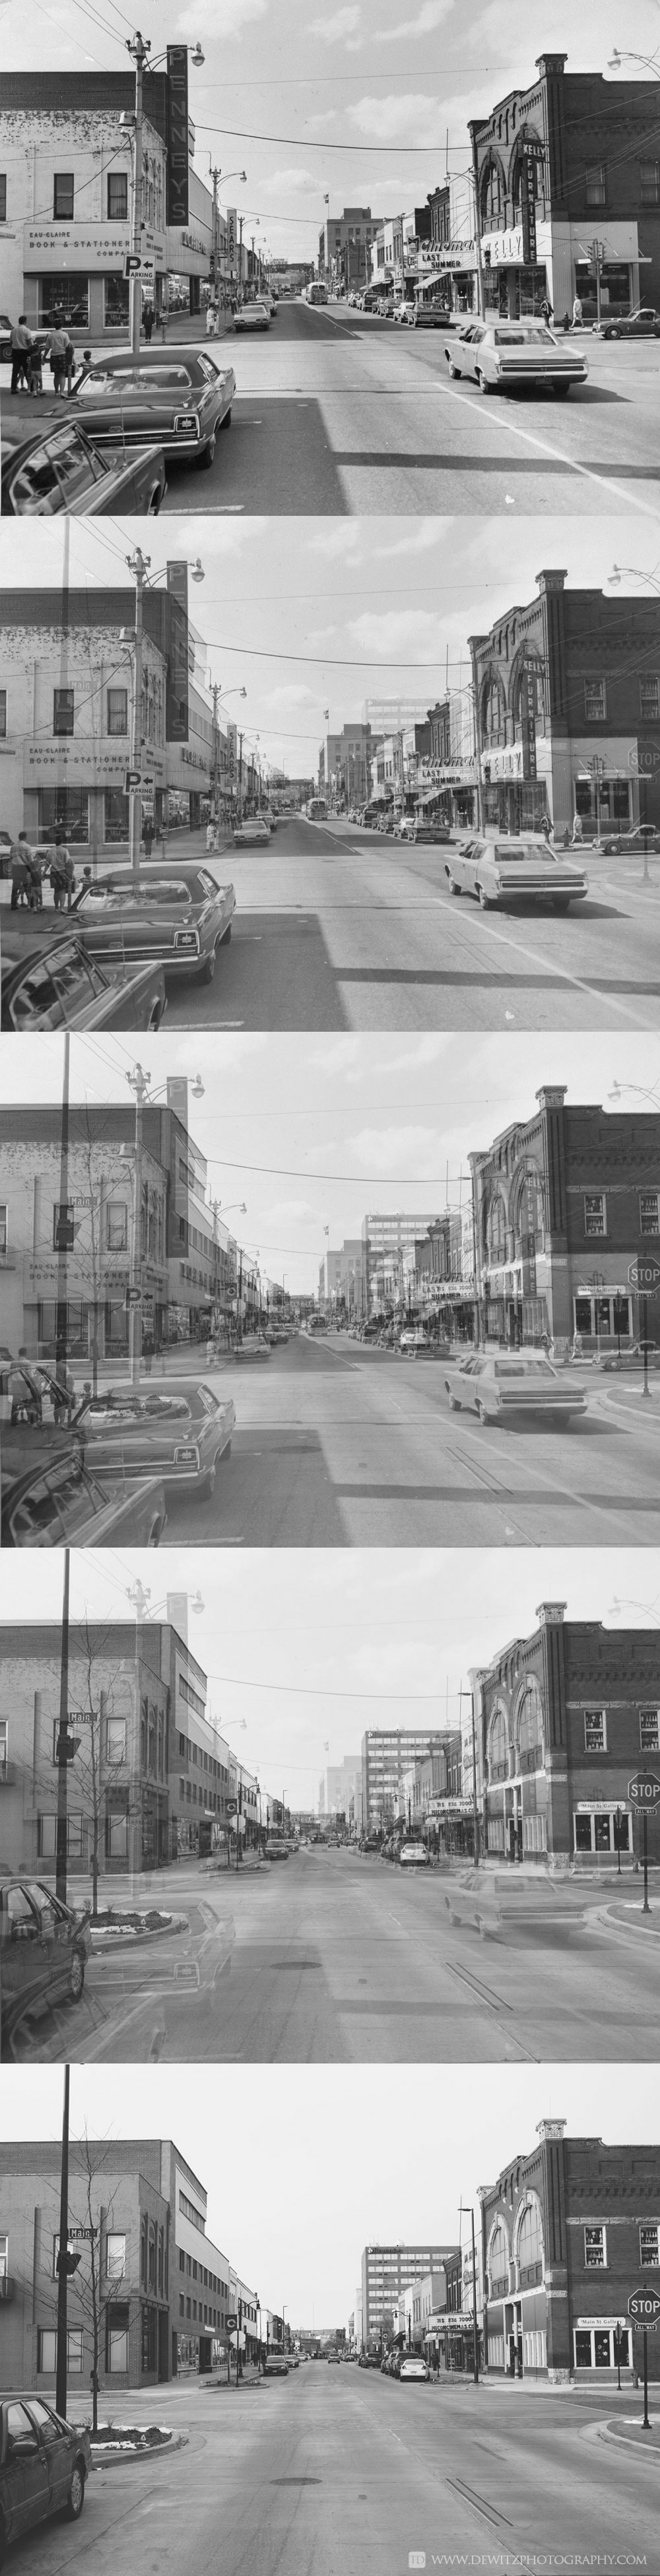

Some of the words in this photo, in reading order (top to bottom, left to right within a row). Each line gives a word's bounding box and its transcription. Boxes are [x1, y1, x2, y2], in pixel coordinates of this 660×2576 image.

[170, 51, 188, 219] PENNEYS
[523, 144, 546, 158] KELLY
[527, 159, 536, 260] FURNITURE
[420, 238, 475, 252] Cinema
[170, 567, 188, 735] PENNEYS
[527, 675, 536, 776] FURNITURE
[420, 754, 475, 768] Cinema
[631, 752, 660, 765] STOP
[631, 1268, 660, 1281] STOP
[631, 1784, 660, 1797] STOP
[631, 2300, 660, 2313] STOP
